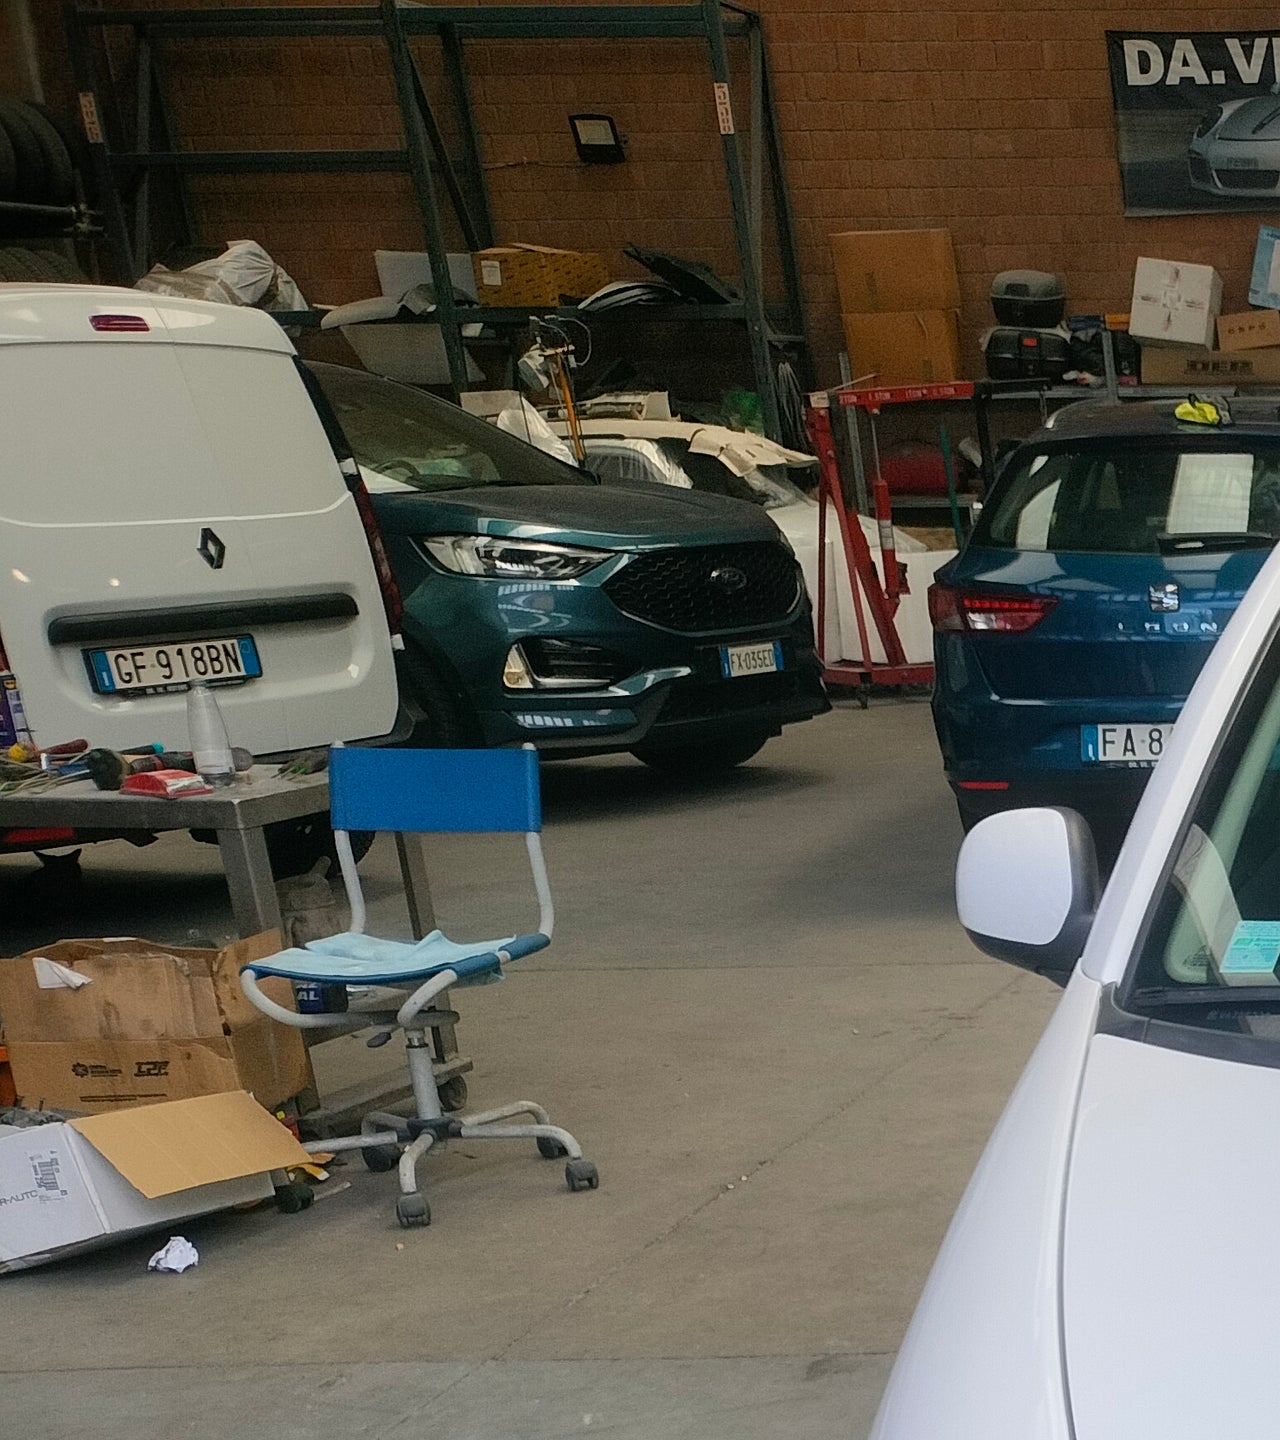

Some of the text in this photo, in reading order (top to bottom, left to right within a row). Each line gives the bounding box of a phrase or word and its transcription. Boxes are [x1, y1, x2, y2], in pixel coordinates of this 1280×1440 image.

[113, 651, 147, 684] GF
[155, 642, 242, 680] 918BN
[1101, 728, 1137, 757] FA
